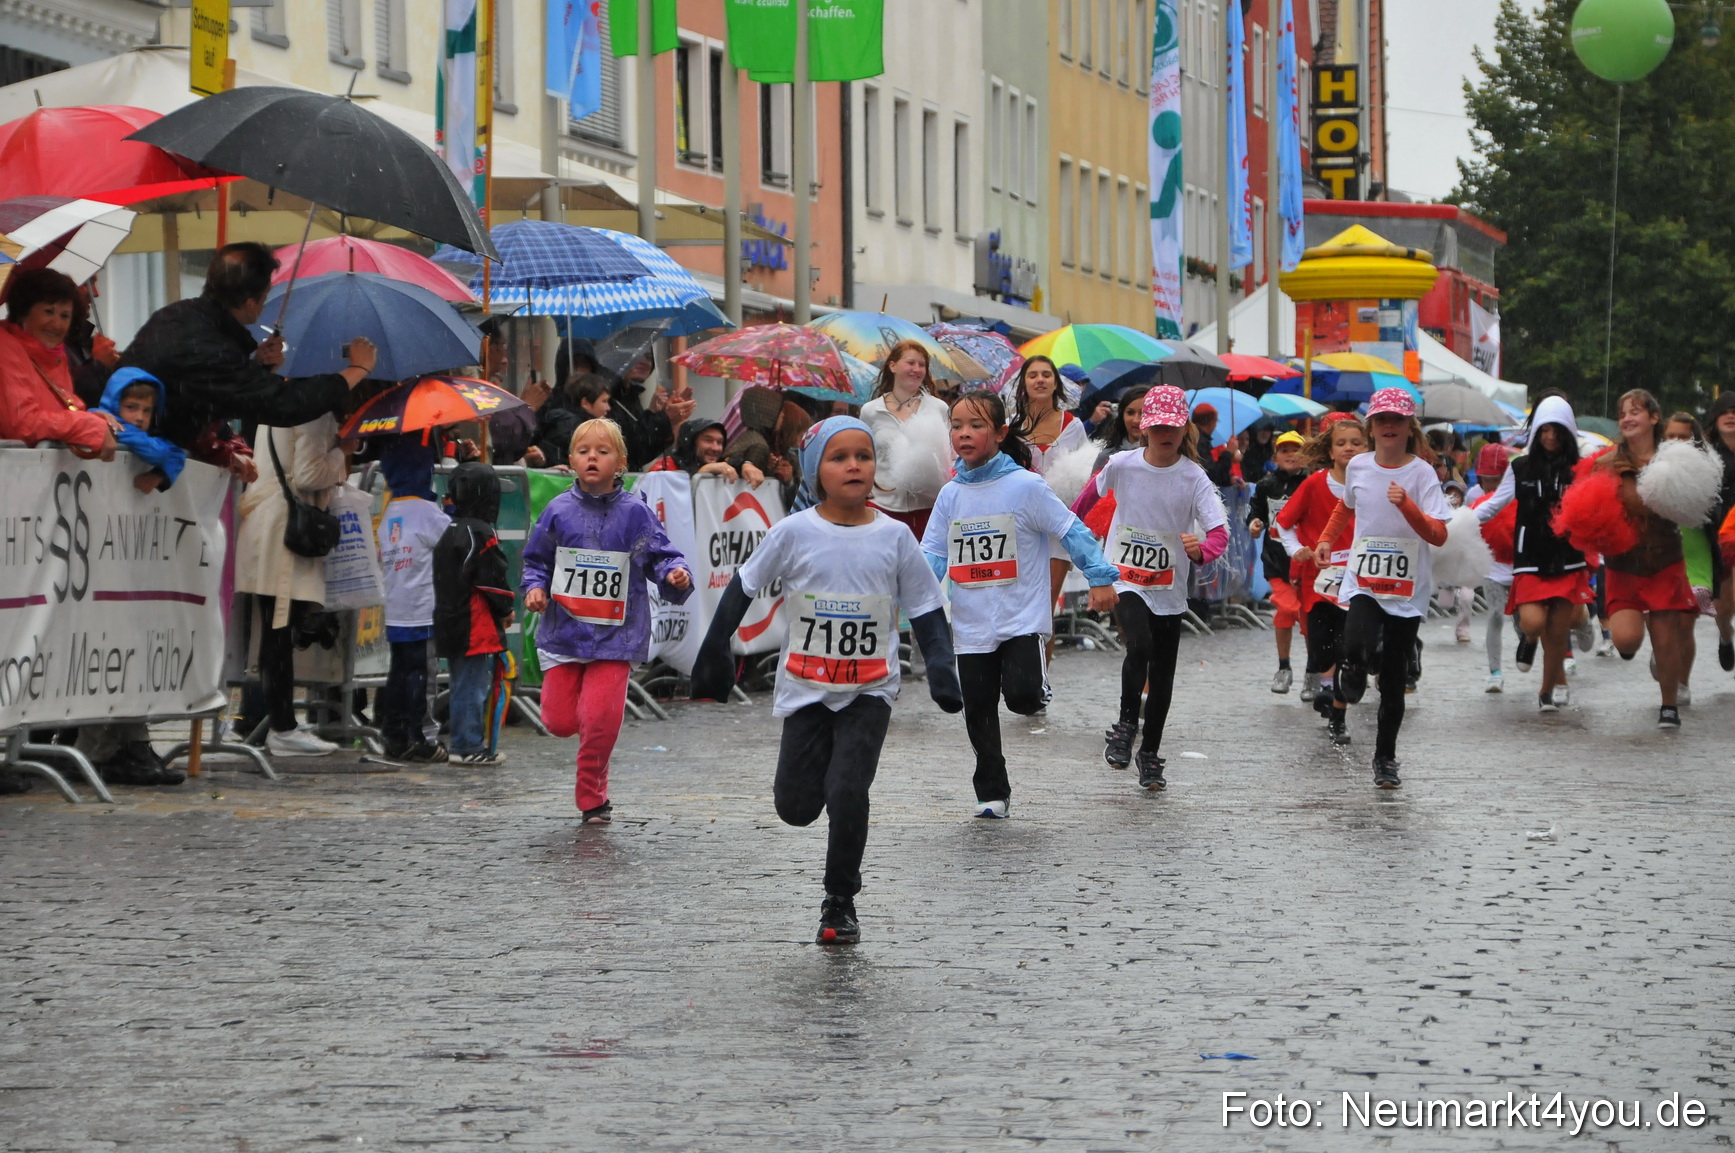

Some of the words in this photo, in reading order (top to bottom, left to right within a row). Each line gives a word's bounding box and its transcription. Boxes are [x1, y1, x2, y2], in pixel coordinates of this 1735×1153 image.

[960, 521, 991, 532] BOCK
[953, 534, 1007, 564] 7137
[1120, 542, 1170, 570] 7020
[1366, 541, 1397, 549] BOCK
[576, 554, 610, 565] BOCK
[1357, 553, 1409, 578] 7019
[564, 568, 622, 599] 7188
[970, 568, 993, 579] Elisa
[1127, 570, 1155, 584] Sarah
[815, 600, 861, 612] BOCK
[800, 616, 878, 656] 7185
[66, 631, 135, 698] Meier
[801, 655, 858, 684] Eva
